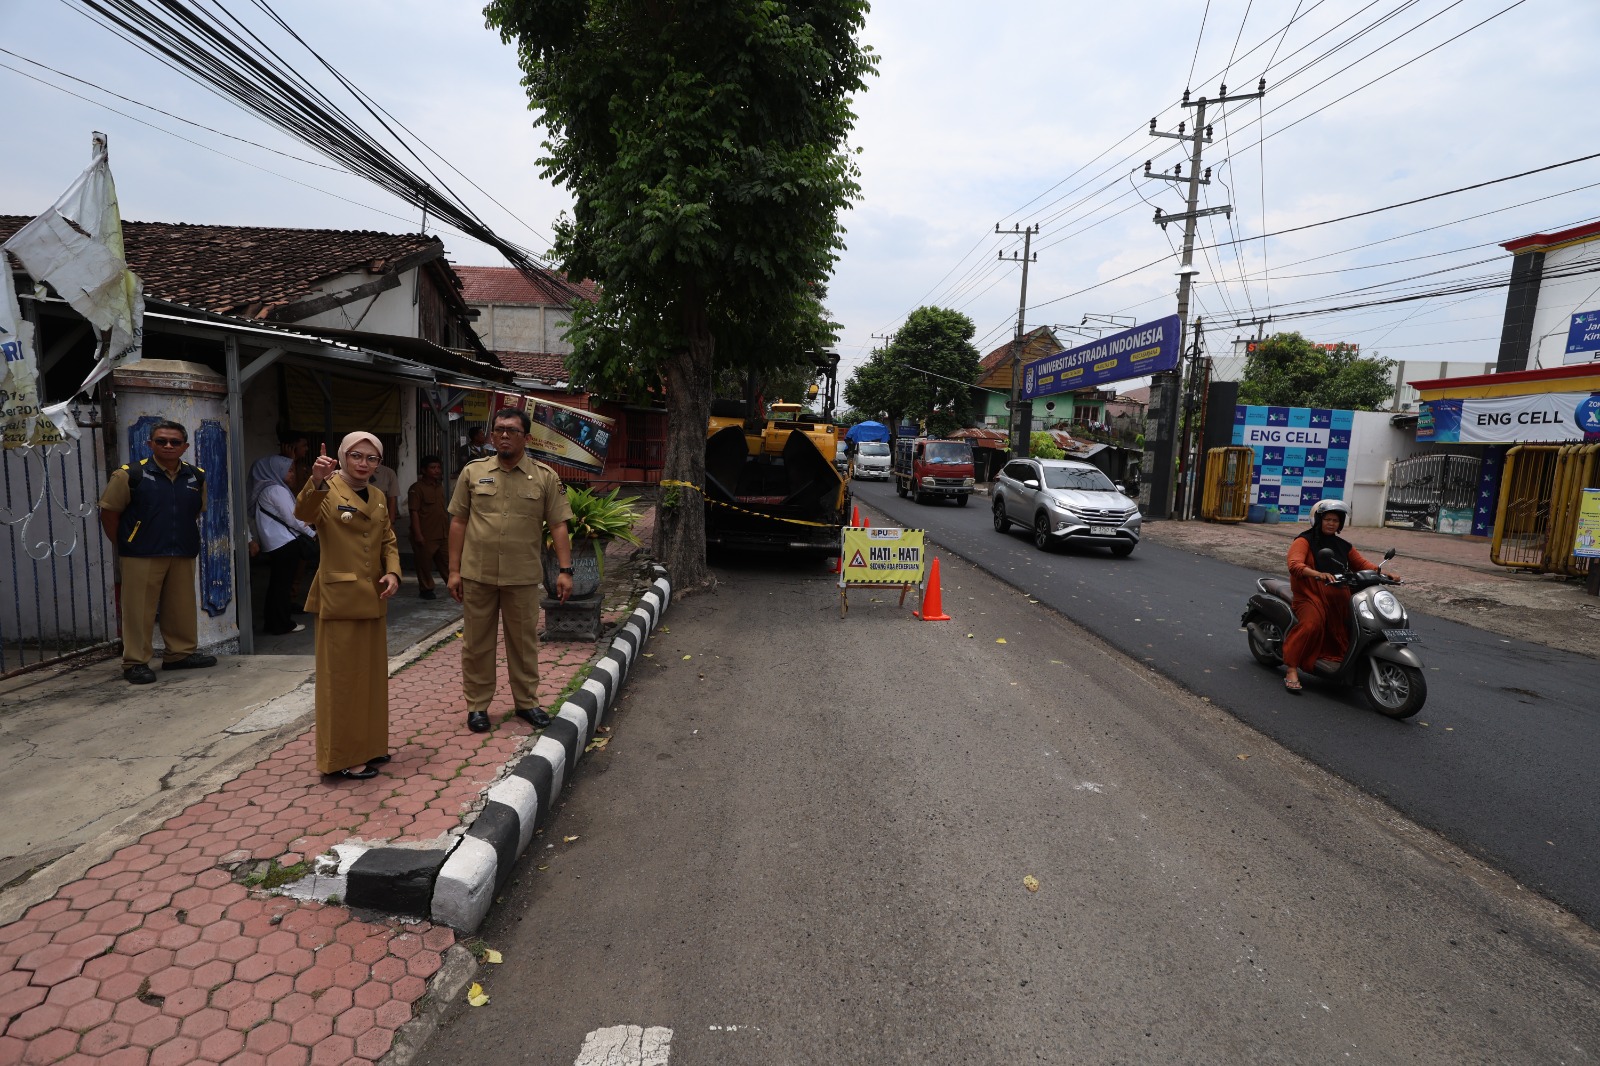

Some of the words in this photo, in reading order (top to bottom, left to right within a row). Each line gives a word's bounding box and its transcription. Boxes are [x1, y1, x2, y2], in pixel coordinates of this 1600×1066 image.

[1038, 353, 1077, 376] UNIVERSITAS
[1078, 346, 1108, 365] STRADA
[1109, 326, 1164, 356] INDONESIA
[1477, 413, 1511, 426] ENG
[1517, 411, 1564, 425] CELL
[1250, 430, 1281, 442] ENG
[1285, 431, 1322, 444] CELL
[869, 547, 891, 561] HATI
[898, 547, 919, 561] HATI
